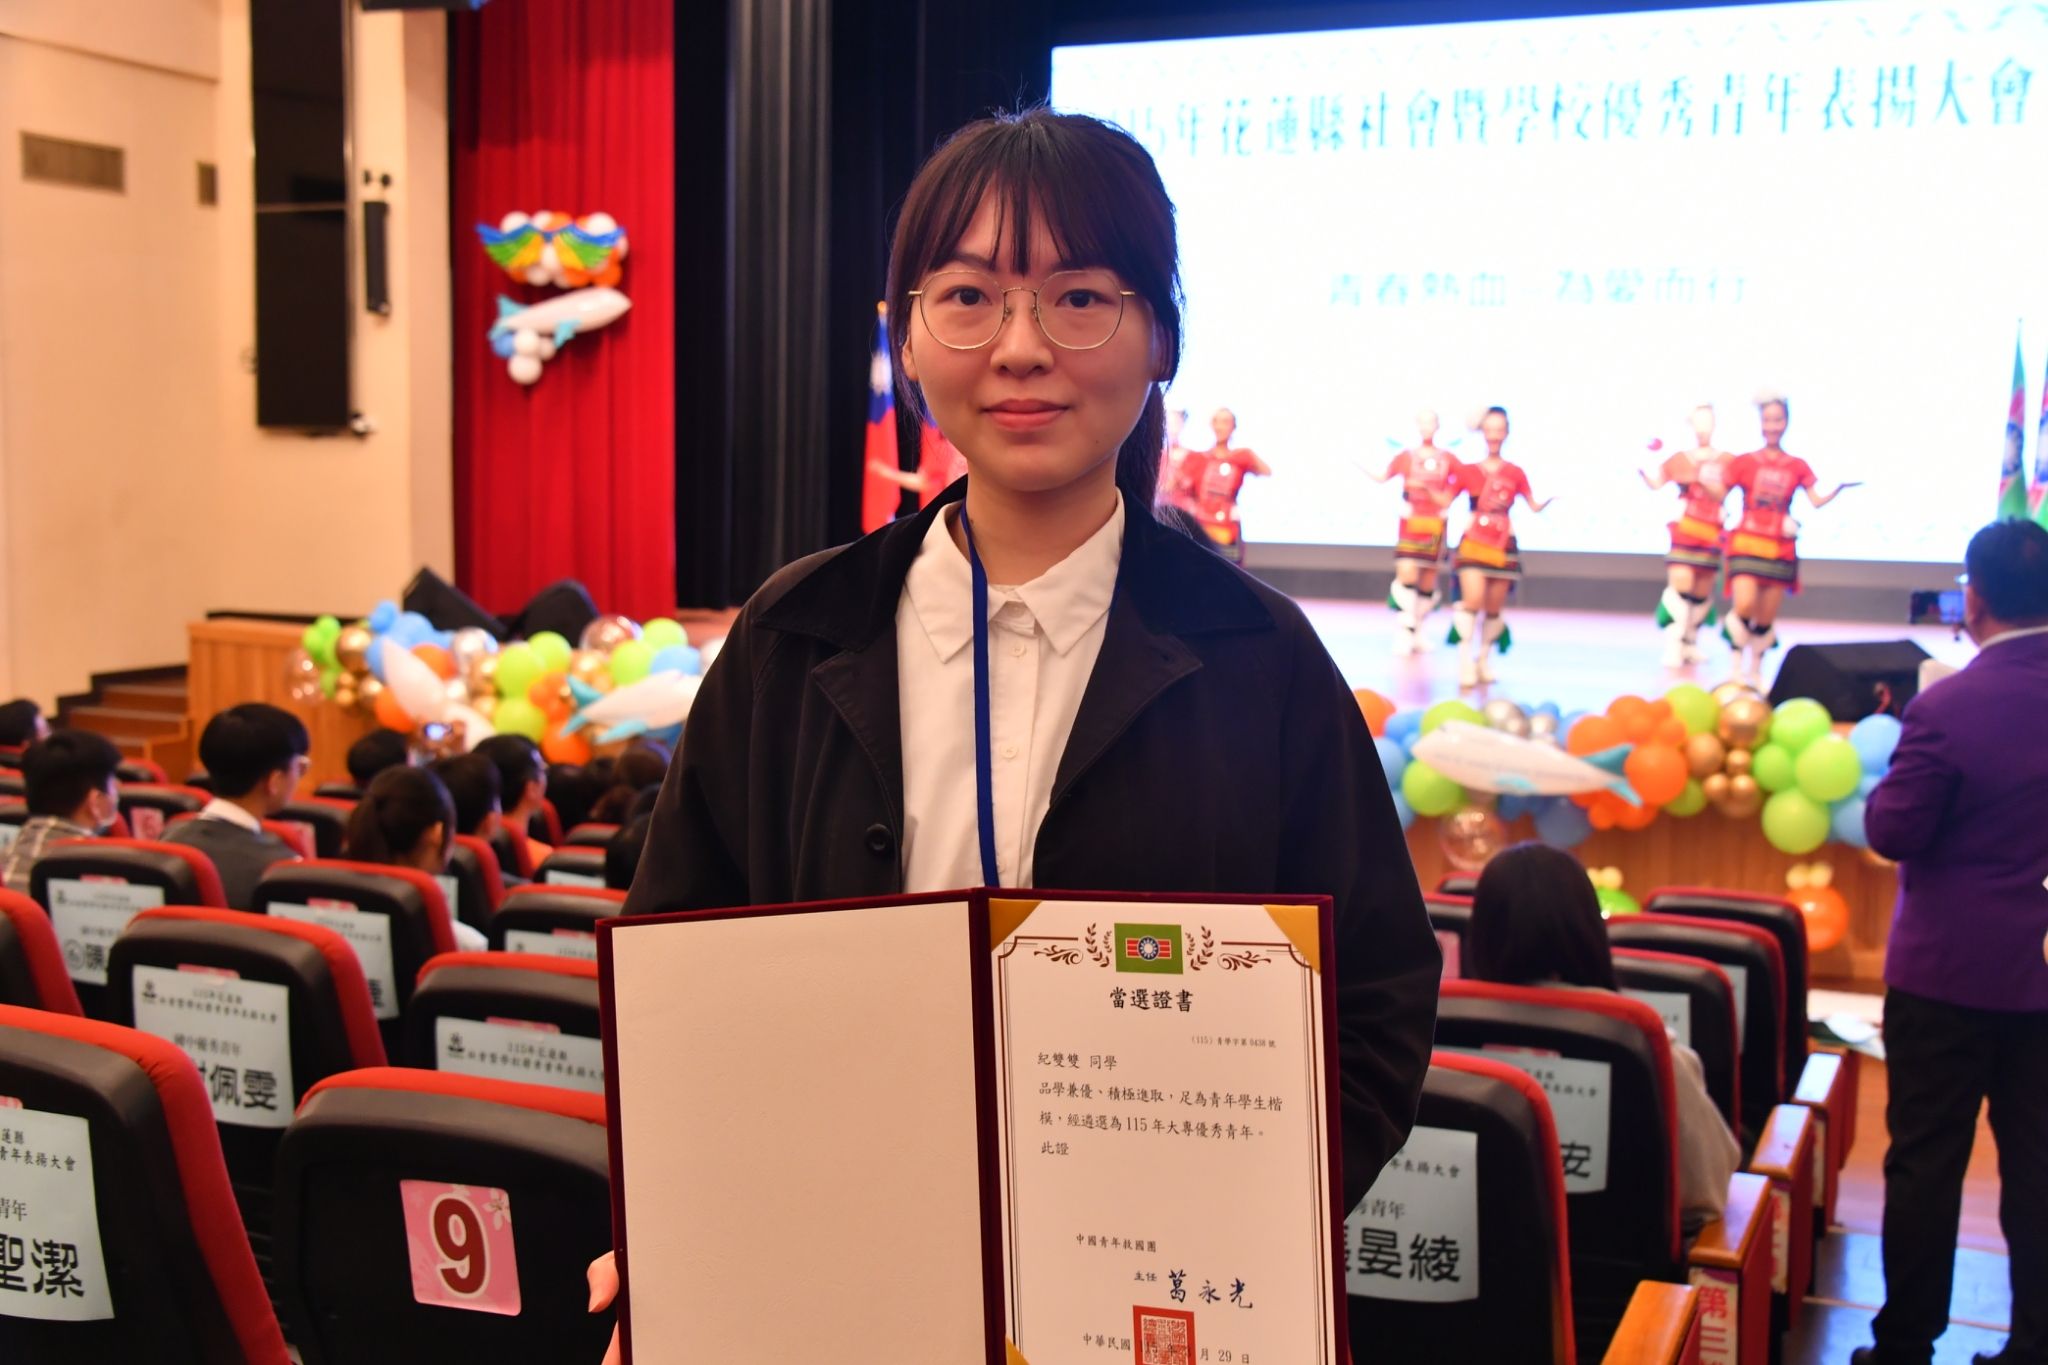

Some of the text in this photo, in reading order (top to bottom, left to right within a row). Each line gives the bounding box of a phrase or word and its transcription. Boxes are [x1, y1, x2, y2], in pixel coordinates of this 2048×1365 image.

[1110, 986, 1194, 1013] 當選證書
[1038, 1052, 1117, 1071] 紀雙雙 同學
[1039, 1082, 1283, 1111] 品學兼優、積極進取，足為青年學生楷
[1041, 1141, 1069, 1156] 此證
[1560, 1139, 1592, 1178] 安
[431, 1194, 488, 1297] 9
[1076, 1232, 1157, 1253] 中國青年救國團
[0, 1233, 85, 1298] 聖潔
[1134, 1268, 1254, 1309] 主任 葛永光
[1698, 1285, 1730, 1365] 第三
[1082, 1332, 1131, 1352] 中華民國
[1217, 1348, 1232, 1362] 29
